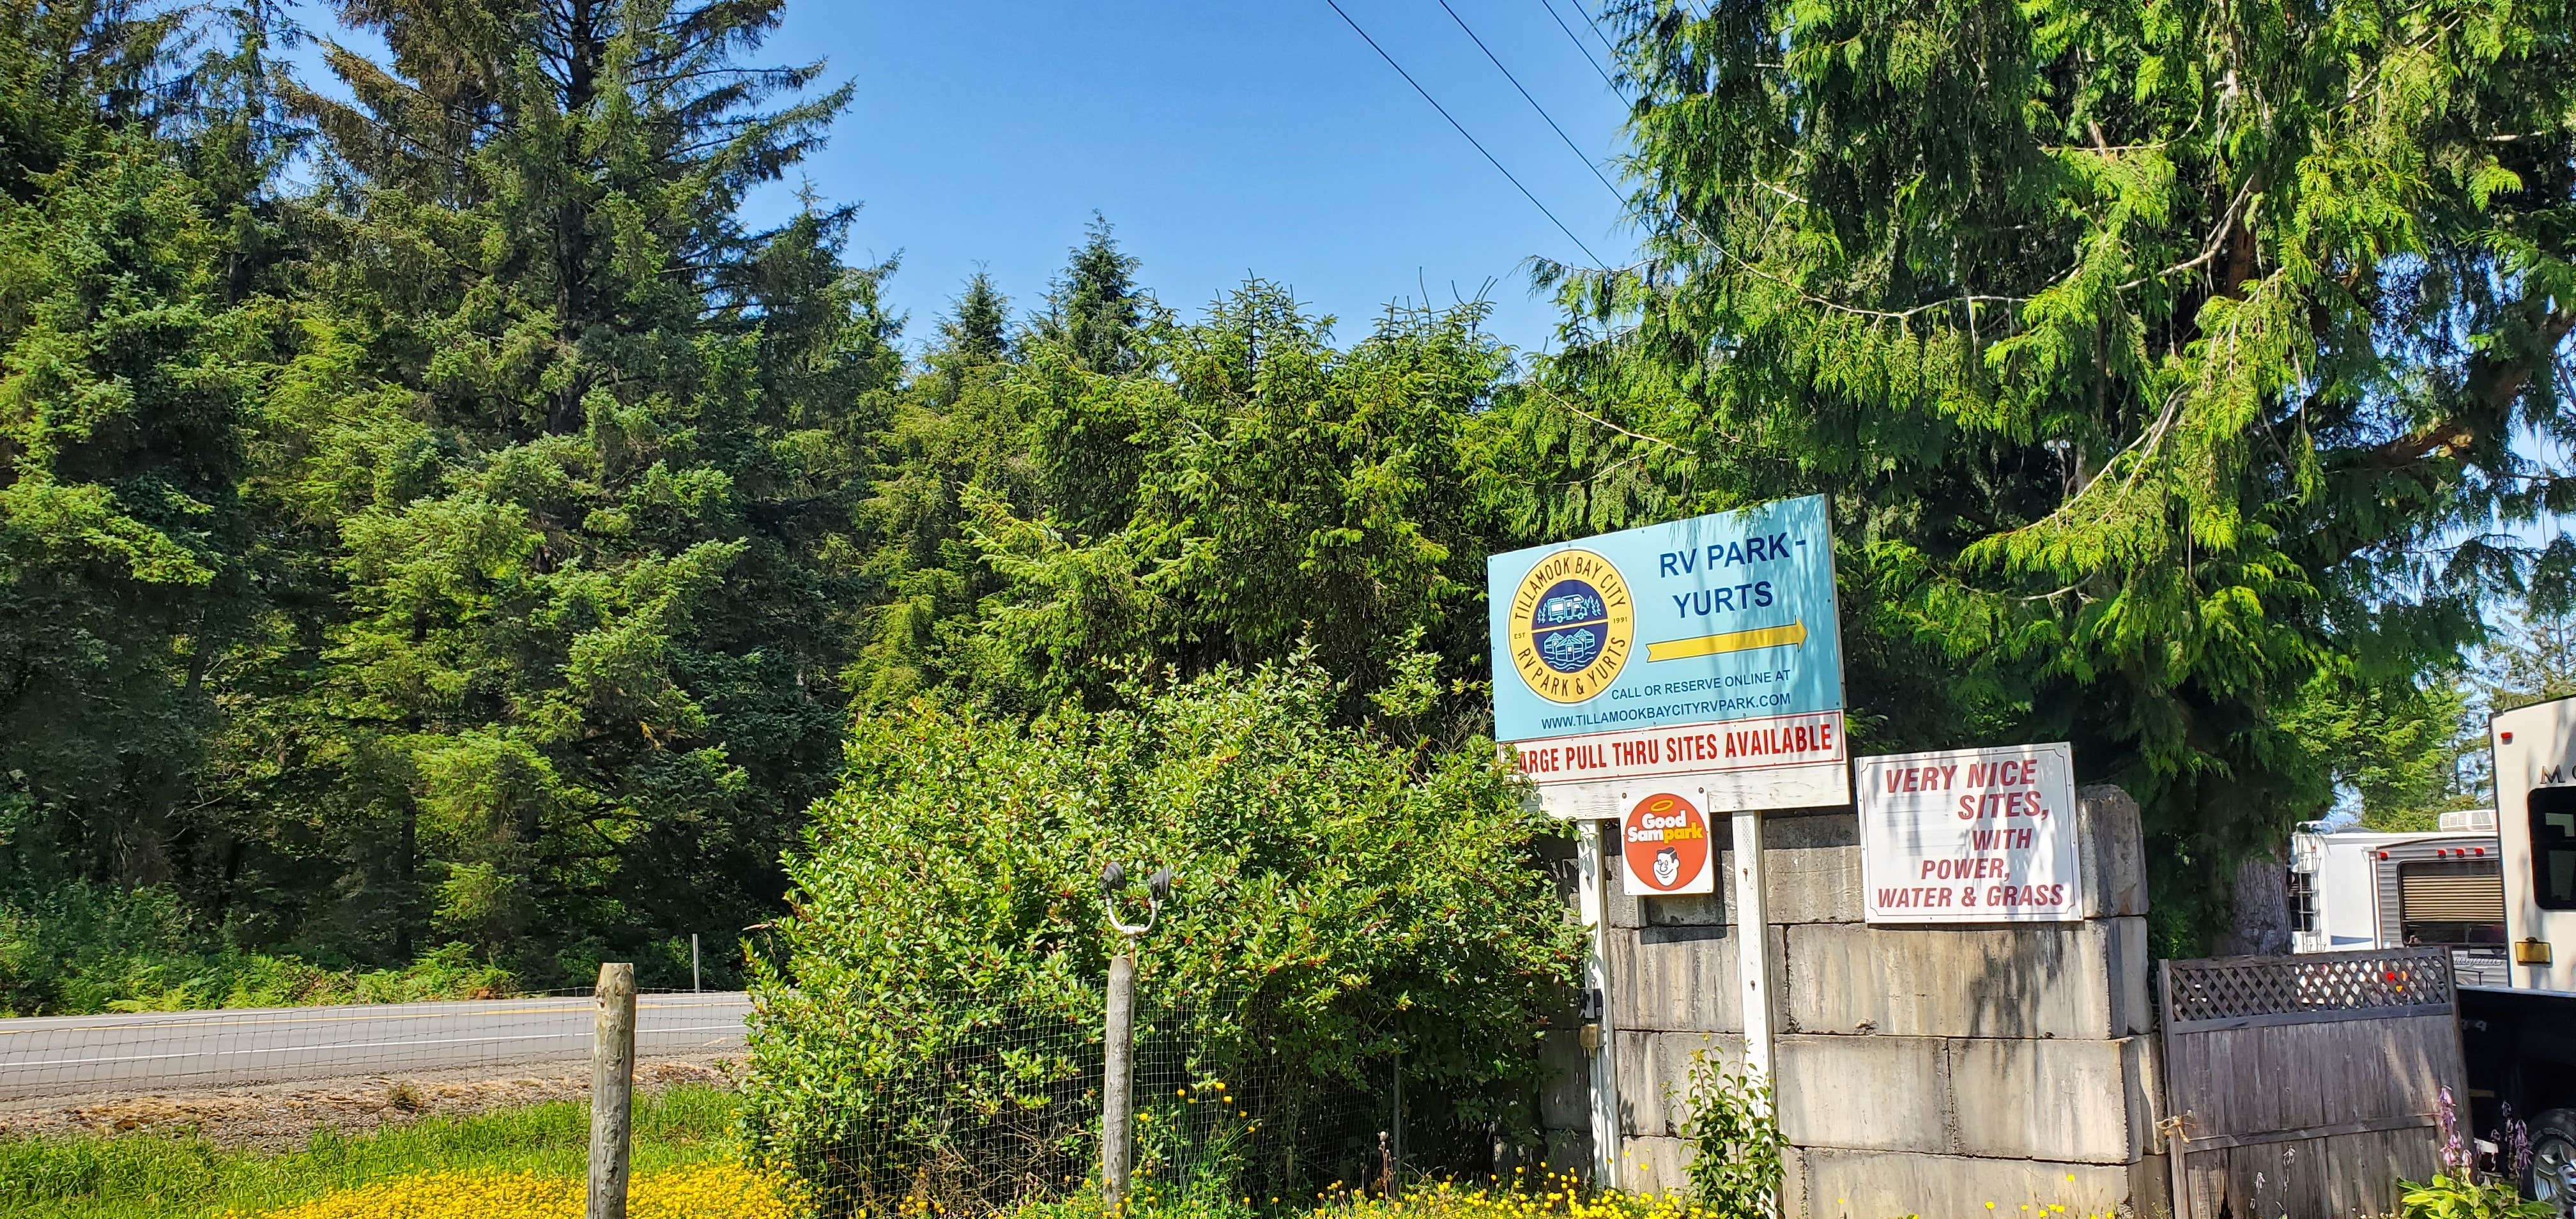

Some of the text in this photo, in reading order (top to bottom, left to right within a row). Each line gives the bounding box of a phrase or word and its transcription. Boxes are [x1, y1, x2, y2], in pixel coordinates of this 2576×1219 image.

[1660, 548, 1697, 578] RV
[1706, 532, 1790, 571] PARK
[1515, 556, 1626, 620] TILLAMOOK BAY CITY
[1671, 581, 1774, 618] YURTS
[1517, 636, 1626, 697] RV PARK & YURTS
[1611, 669, 1791, 700] CALL OR RESERVE ONLINE AT
[1542, 693, 1791, 730] WWW.TILLAMOOKBAYCITYRVPARK.COM
[1519, 724, 1832, 774] ARGE PULL THRU SITES AVAILABLE
[1885, 759, 2038, 793] VERY NICE
[1641, 809, 1687, 829] Good
[1958, 790, 2050, 821] SITES,
[1972, 828, 2032, 851] WITH
[1920, 857, 2011, 882] POWER,
[1877, 884, 2064, 908] WATER & GRASS
